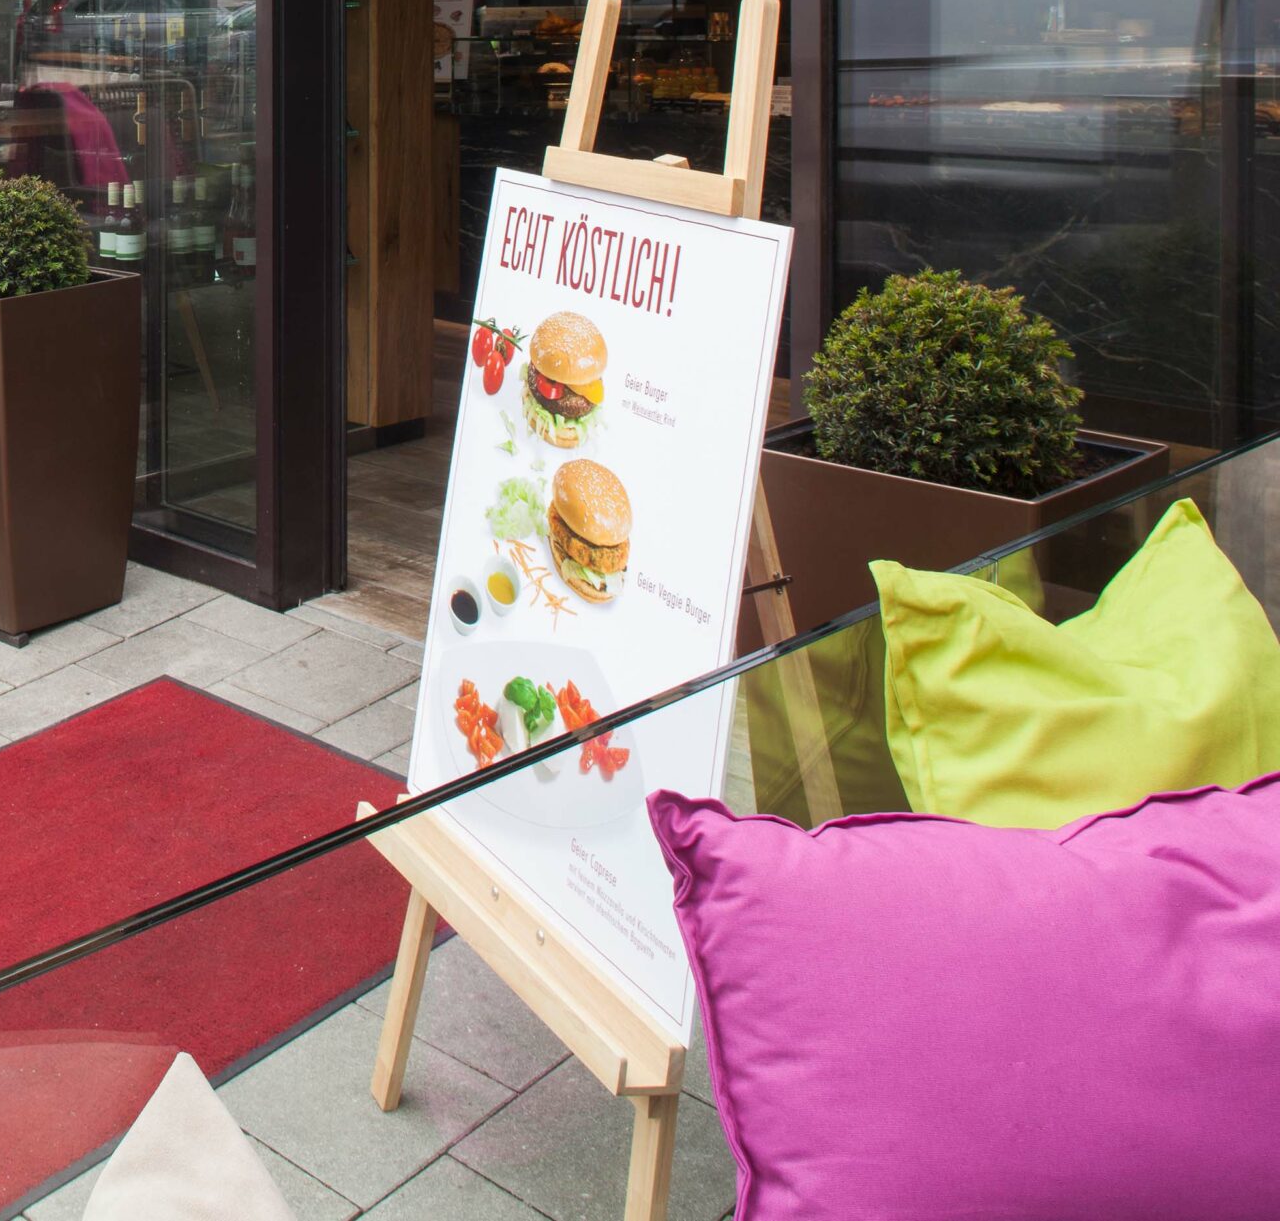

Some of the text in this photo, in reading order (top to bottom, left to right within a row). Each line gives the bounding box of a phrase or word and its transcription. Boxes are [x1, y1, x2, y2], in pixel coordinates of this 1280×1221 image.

[500, 206, 681, 317] ECHT KÖSTLICH!
[624, 372, 668, 403] Geier Burger
[637, 572, 711, 625] Geier Veggie Burger
[570, 837, 617, 888] Geier Caprese
